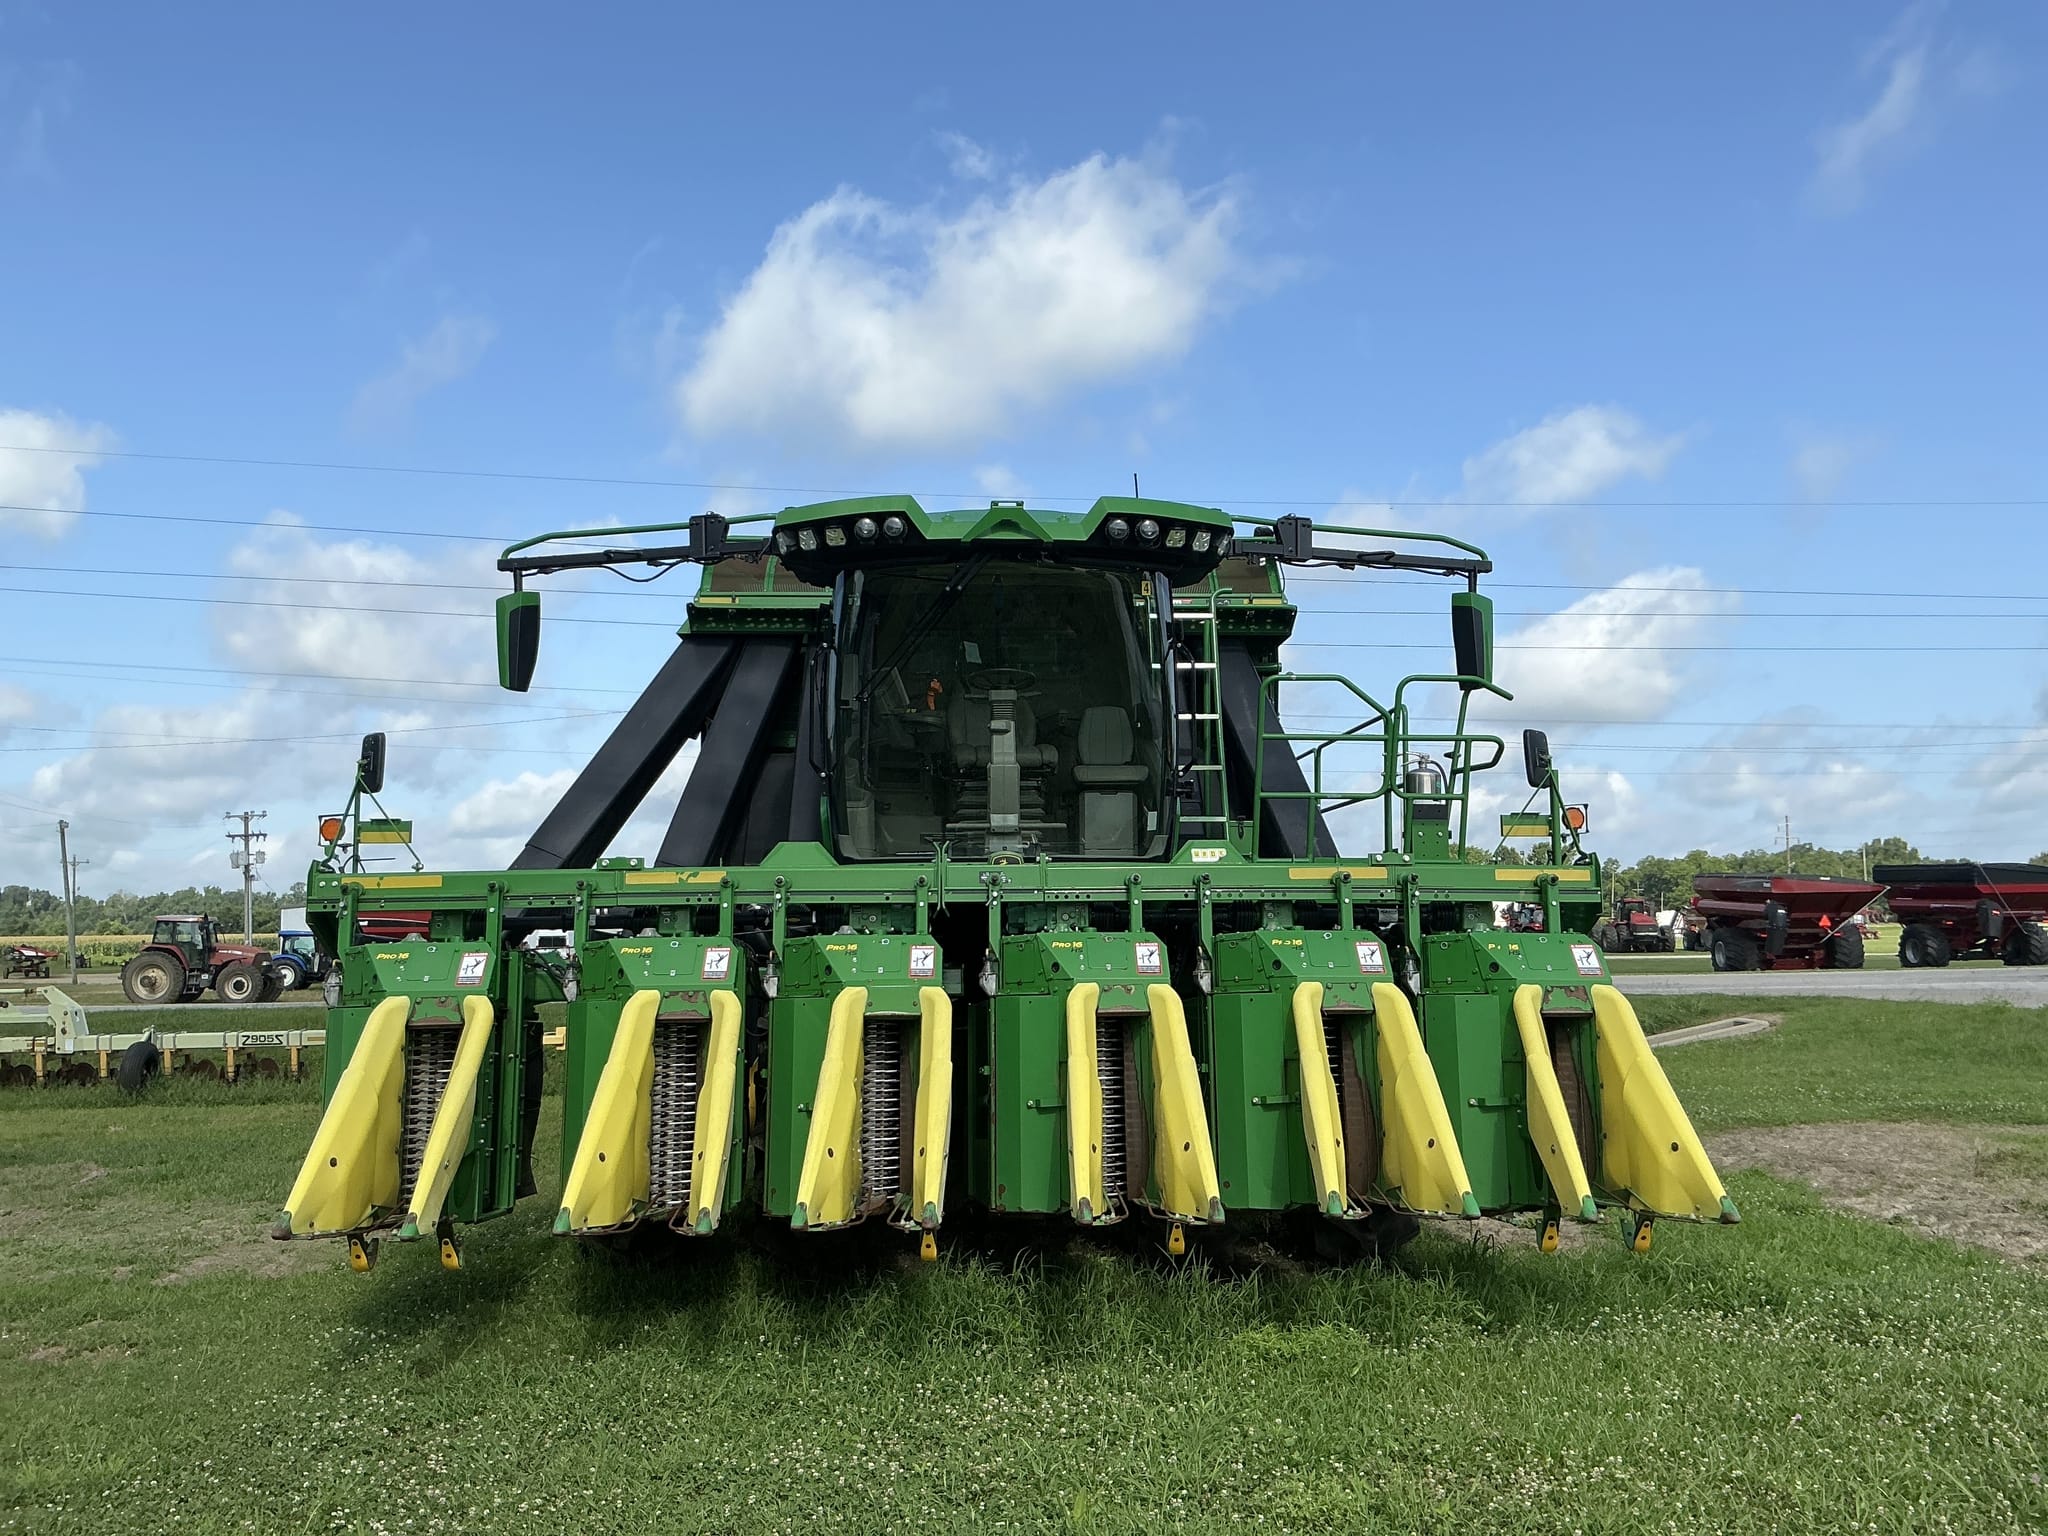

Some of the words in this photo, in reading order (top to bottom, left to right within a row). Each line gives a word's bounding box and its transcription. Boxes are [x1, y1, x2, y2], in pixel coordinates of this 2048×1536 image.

[1143, 582, 1149, 594] 4
[642, 946, 653, 954] 16
[847, 943, 858, 951] 16
[1508, 943, 1519, 951] 16
